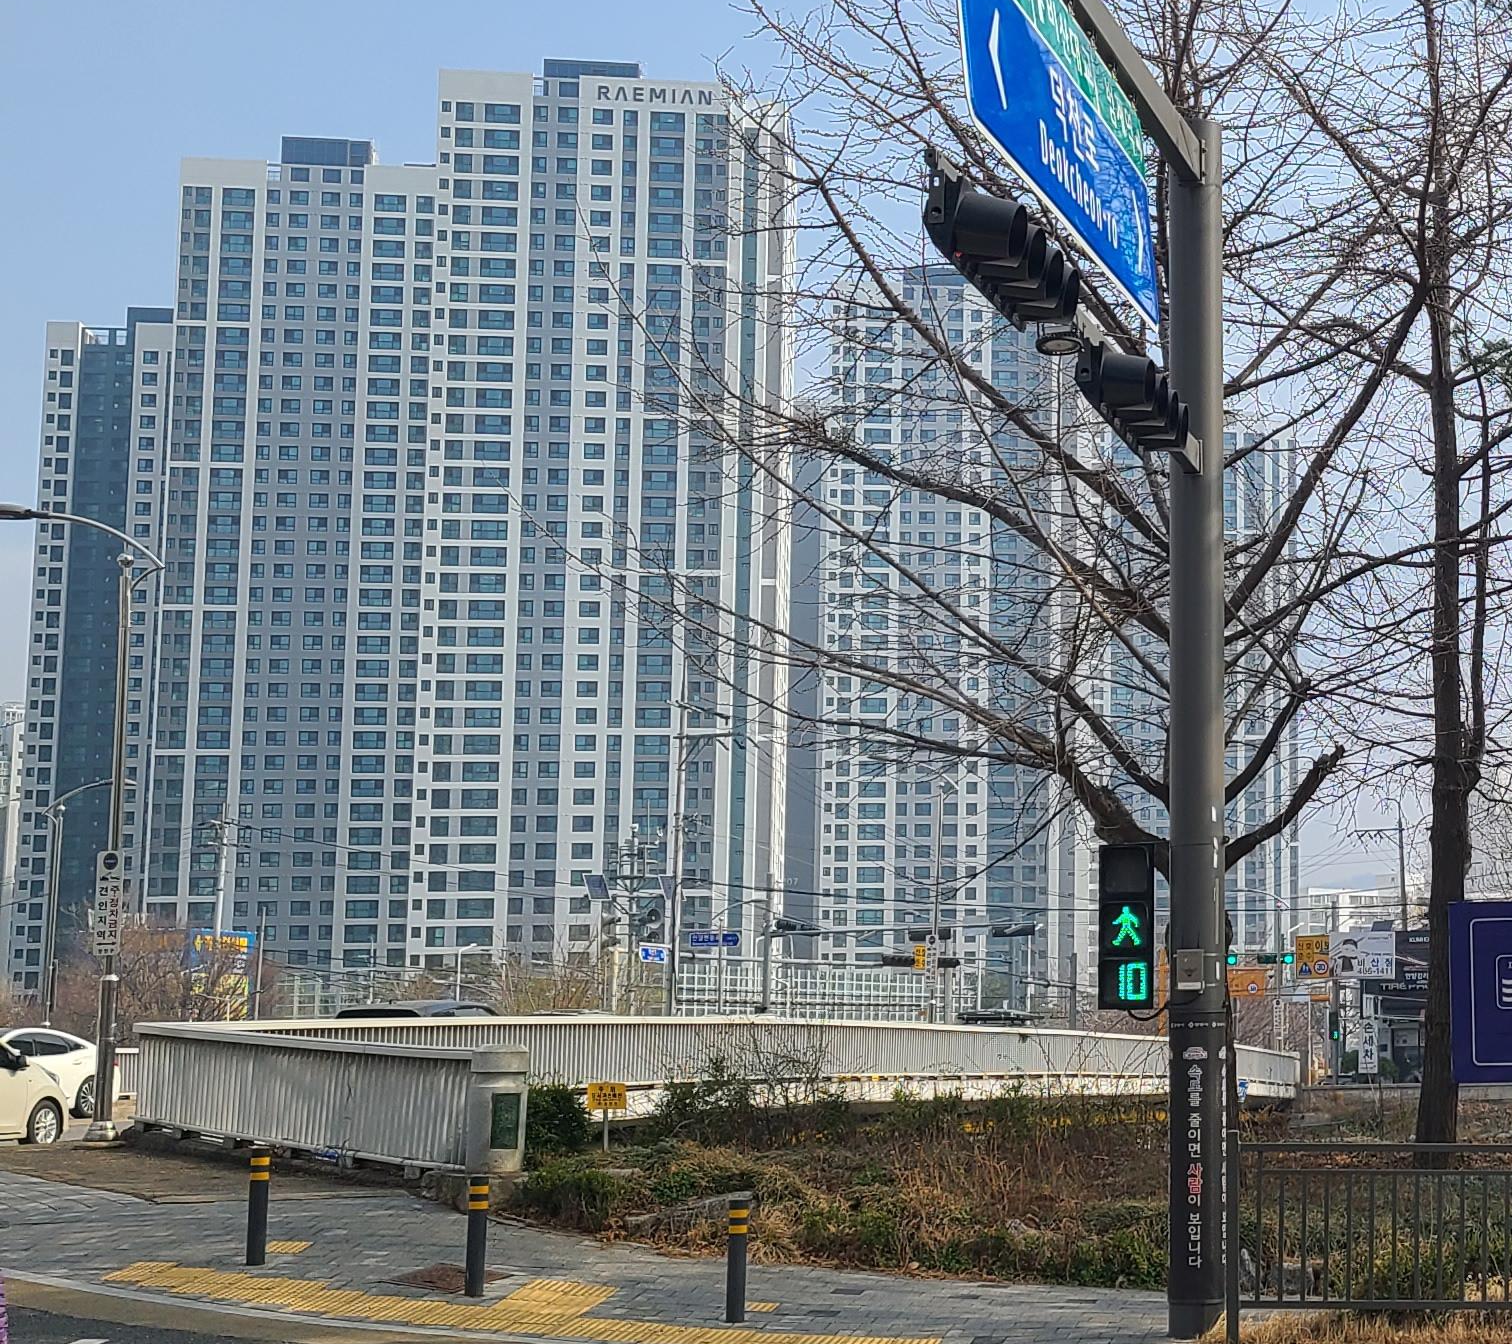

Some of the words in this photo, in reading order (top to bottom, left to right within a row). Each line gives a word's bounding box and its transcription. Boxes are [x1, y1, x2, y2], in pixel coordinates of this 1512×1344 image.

[597, 85, 713, 105] RAEMIAN
[1049, 66, 1099, 172] 덕천로
[1039, 118, 1118, 249] Deokcheon-ro
[1118, 962, 1148, 1000] 10
[1187, 1113, 1203, 1157] 줄이면
[1187, 1162, 1203, 1207] 사람이
[1187, 1212, 1203, 1269] 보입니다
